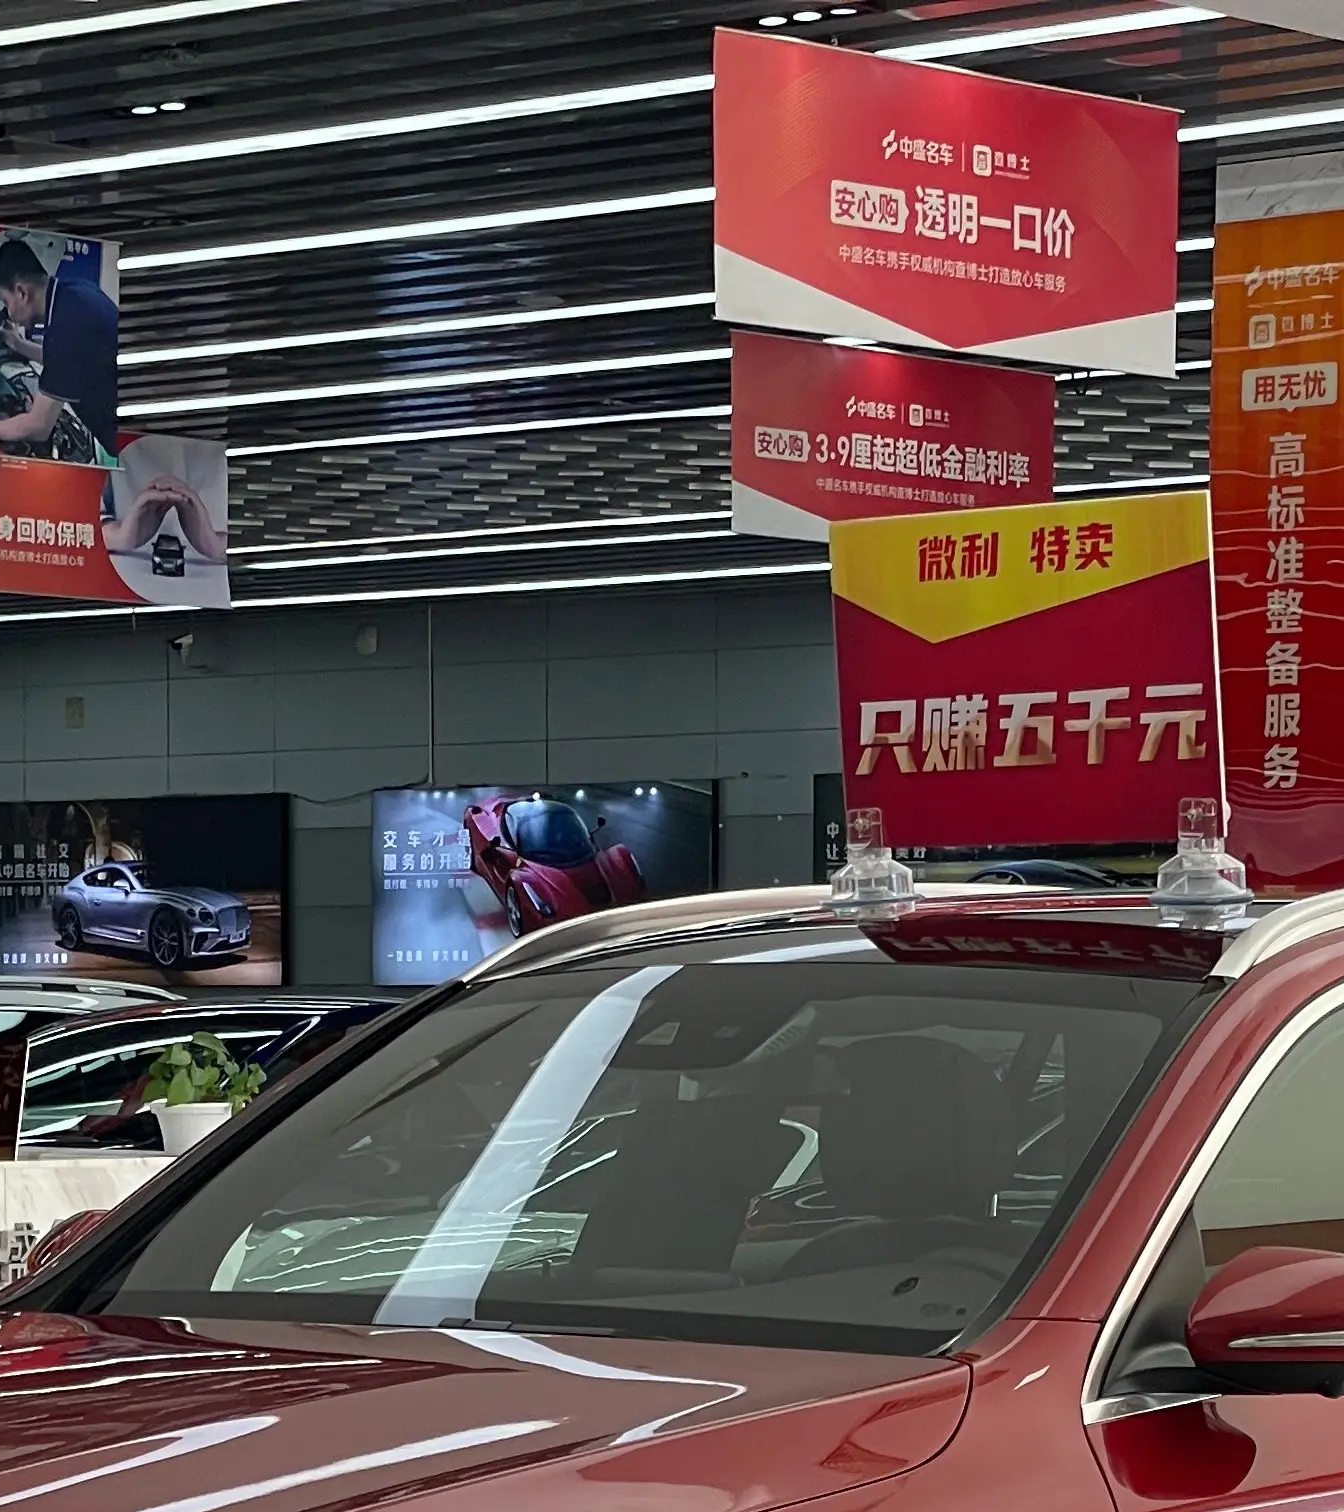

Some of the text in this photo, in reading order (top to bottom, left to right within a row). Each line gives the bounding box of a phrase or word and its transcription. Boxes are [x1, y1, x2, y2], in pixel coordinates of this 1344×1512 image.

[900, 135, 954, 167] 中盛名车
[835, 185, 1076, 259] 安心购 透明一口价
[839, 243, 1067, 294] 中盛名车携手权威机构查博士打造放心车服务
[1267, 265, 1340, 290] 中盛名车
[1253, 370, 1326, 404] 用无忧
[858, 400, 896, 420] 中盛名车
[758, 431, 1030, 489] 安心购 3.9厘起超低金融利率
[918, 522, 1113, 583] 微利 特卖
[1263, 432, 1307, 790] 高标准整备服务
[855, 682, 1207, 776] 只赚五千元
[384, 829, 470, 848] 交车才是
[384, 853, 471, 870] 服务的开始
